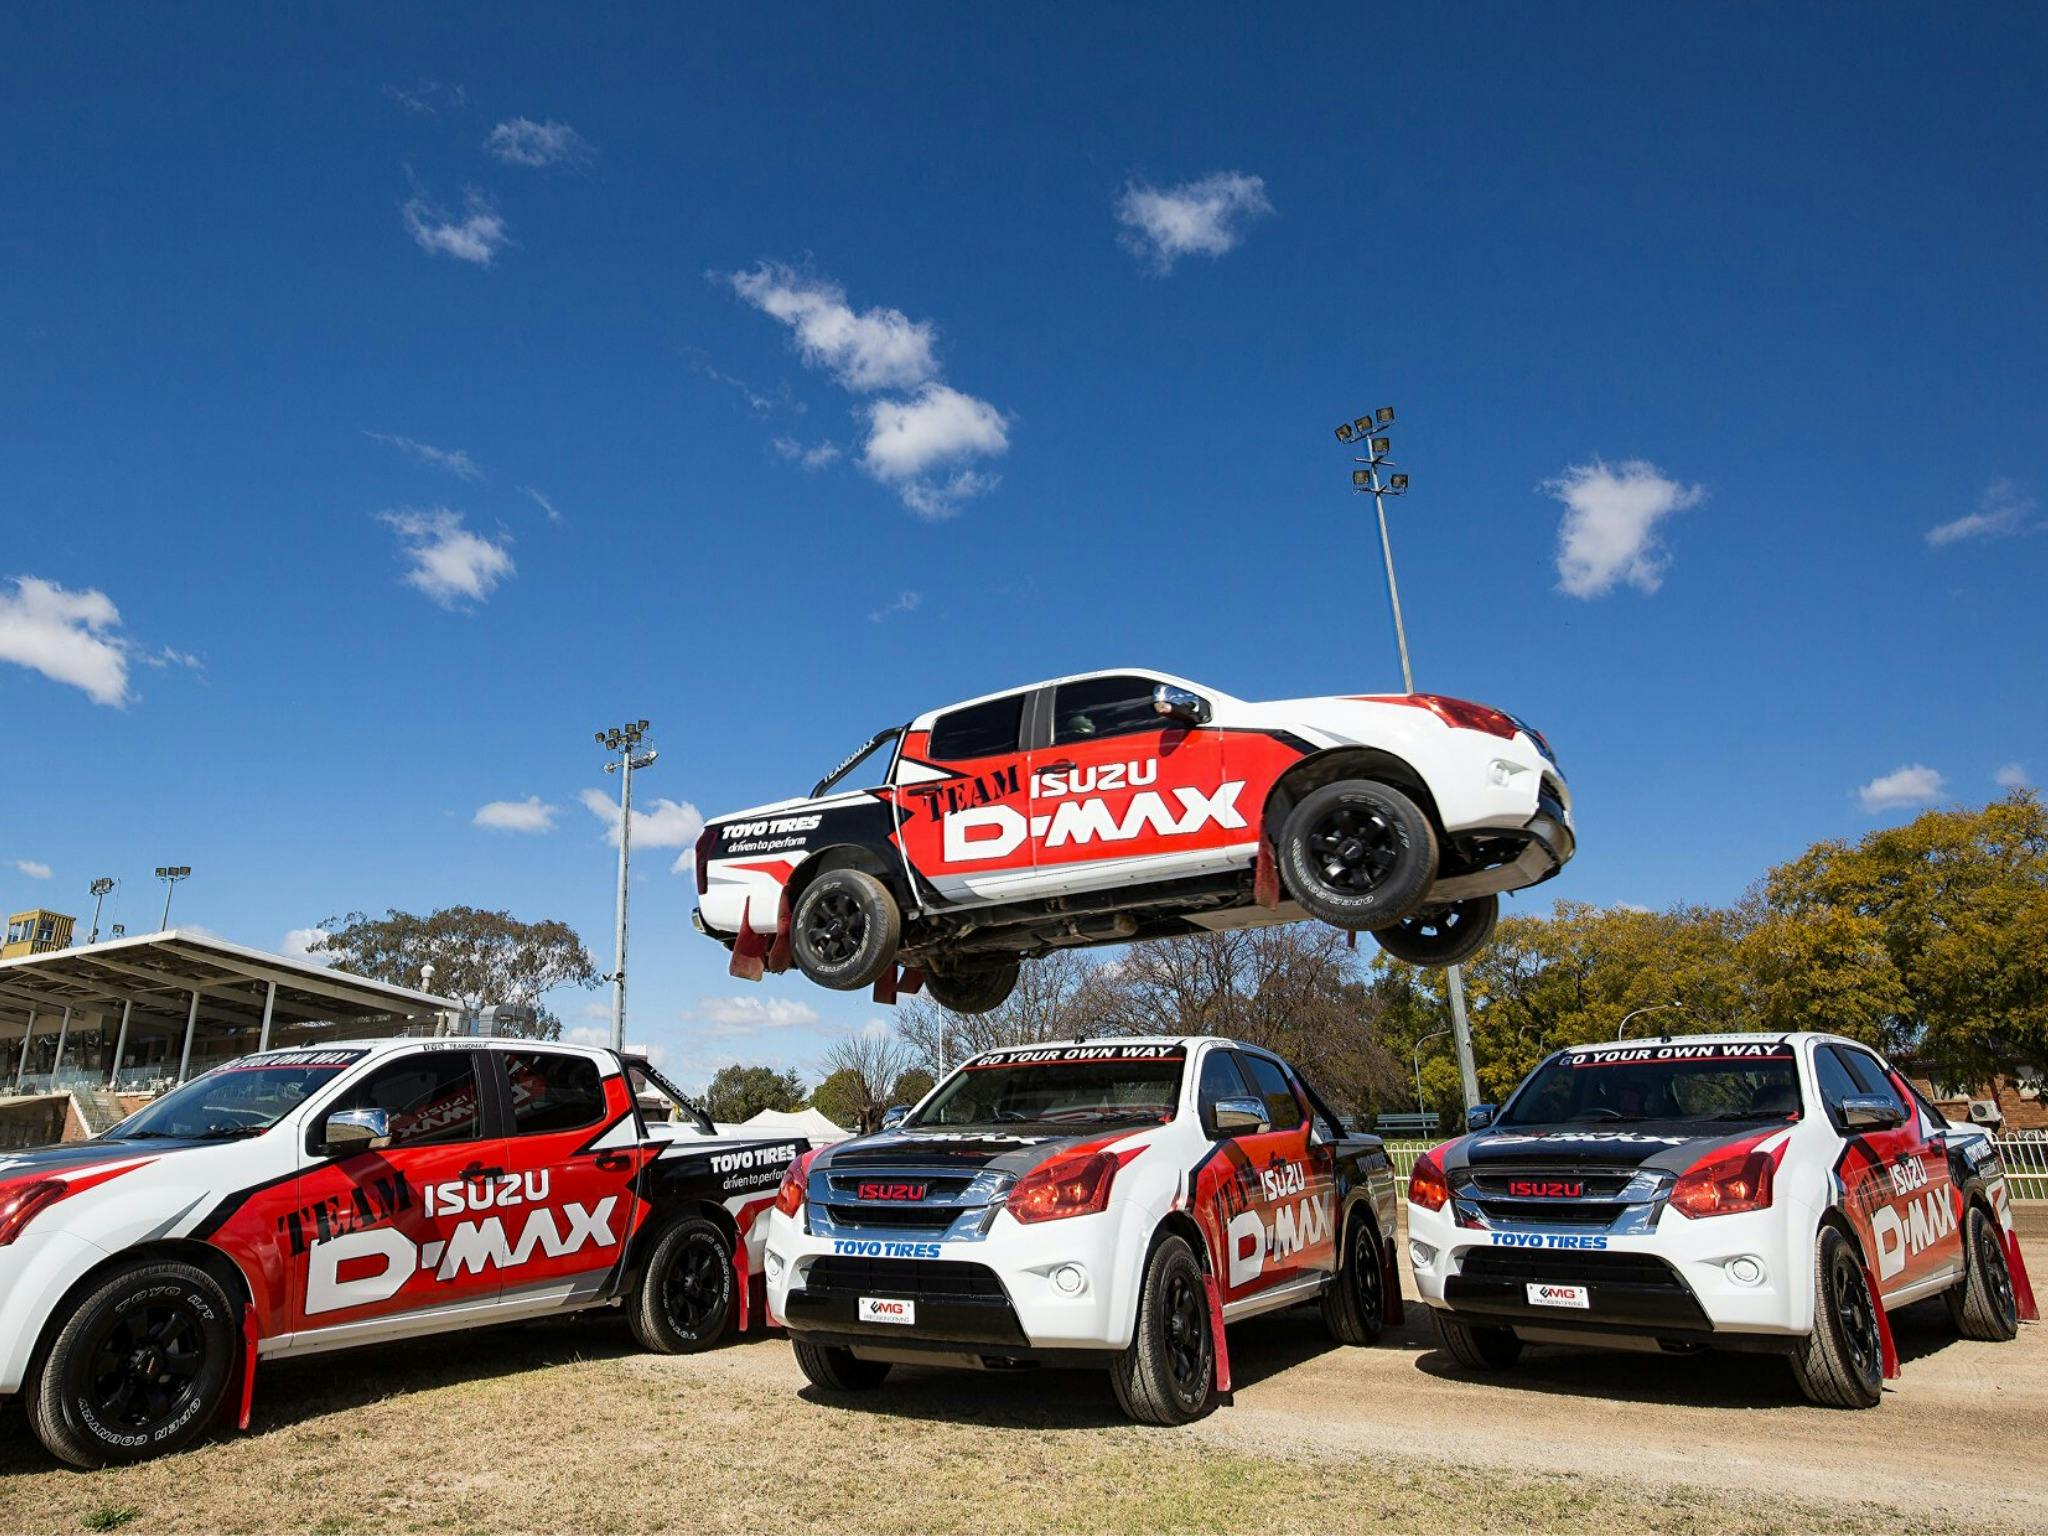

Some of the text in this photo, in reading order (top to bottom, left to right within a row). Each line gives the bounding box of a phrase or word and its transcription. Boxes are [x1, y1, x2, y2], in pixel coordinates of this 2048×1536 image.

[922, 765, 1021, 822] TEAM
[1030, 758, 1157, 799] ISUZU
[722, 815, 822, 839] TOYO TIRES
[943, 780, 1248, 862] D-MAX
[728, 837, 807, 852] driven to perform
[977, 1046, 1173, 1067] GO YOUR OWN WAY
[1592, 1050, 1651, 1062] YOUR
[1658, 1046, 1714, 1058] OWN
[1721, 1045, 1780, 1056] WAY
[711, 1144, 797, 1174] TOYO TIRES
[1889, 1155, 1927, 1196] ISUZU
[424, 1169, 549, 1218] ISUZU
[723, 1168, 788, 1190] driven to perfor
[858, 1183, 927, 1200] ISUZU
[1260, 1162, 1305, 1202] ISUZU
[1508, 1182, 1583, 1197] ISUZU
[277, 1171, 414, 1257] TEAM
[833, 1240, 942, 1258] TOYO TIRES
[1227, 1190, 1332, 1289] D-MAX
[1491, 1233, 1608, 1249] TOYO TIRES
[1871, 1183, 1957, 1281] D-MAX
[304, 1195, 619, 1315] D-MAX
[114, 1286, 182, 1313] TOYO
[78, 1396, 201, 1446] OPEN COUNTRY
